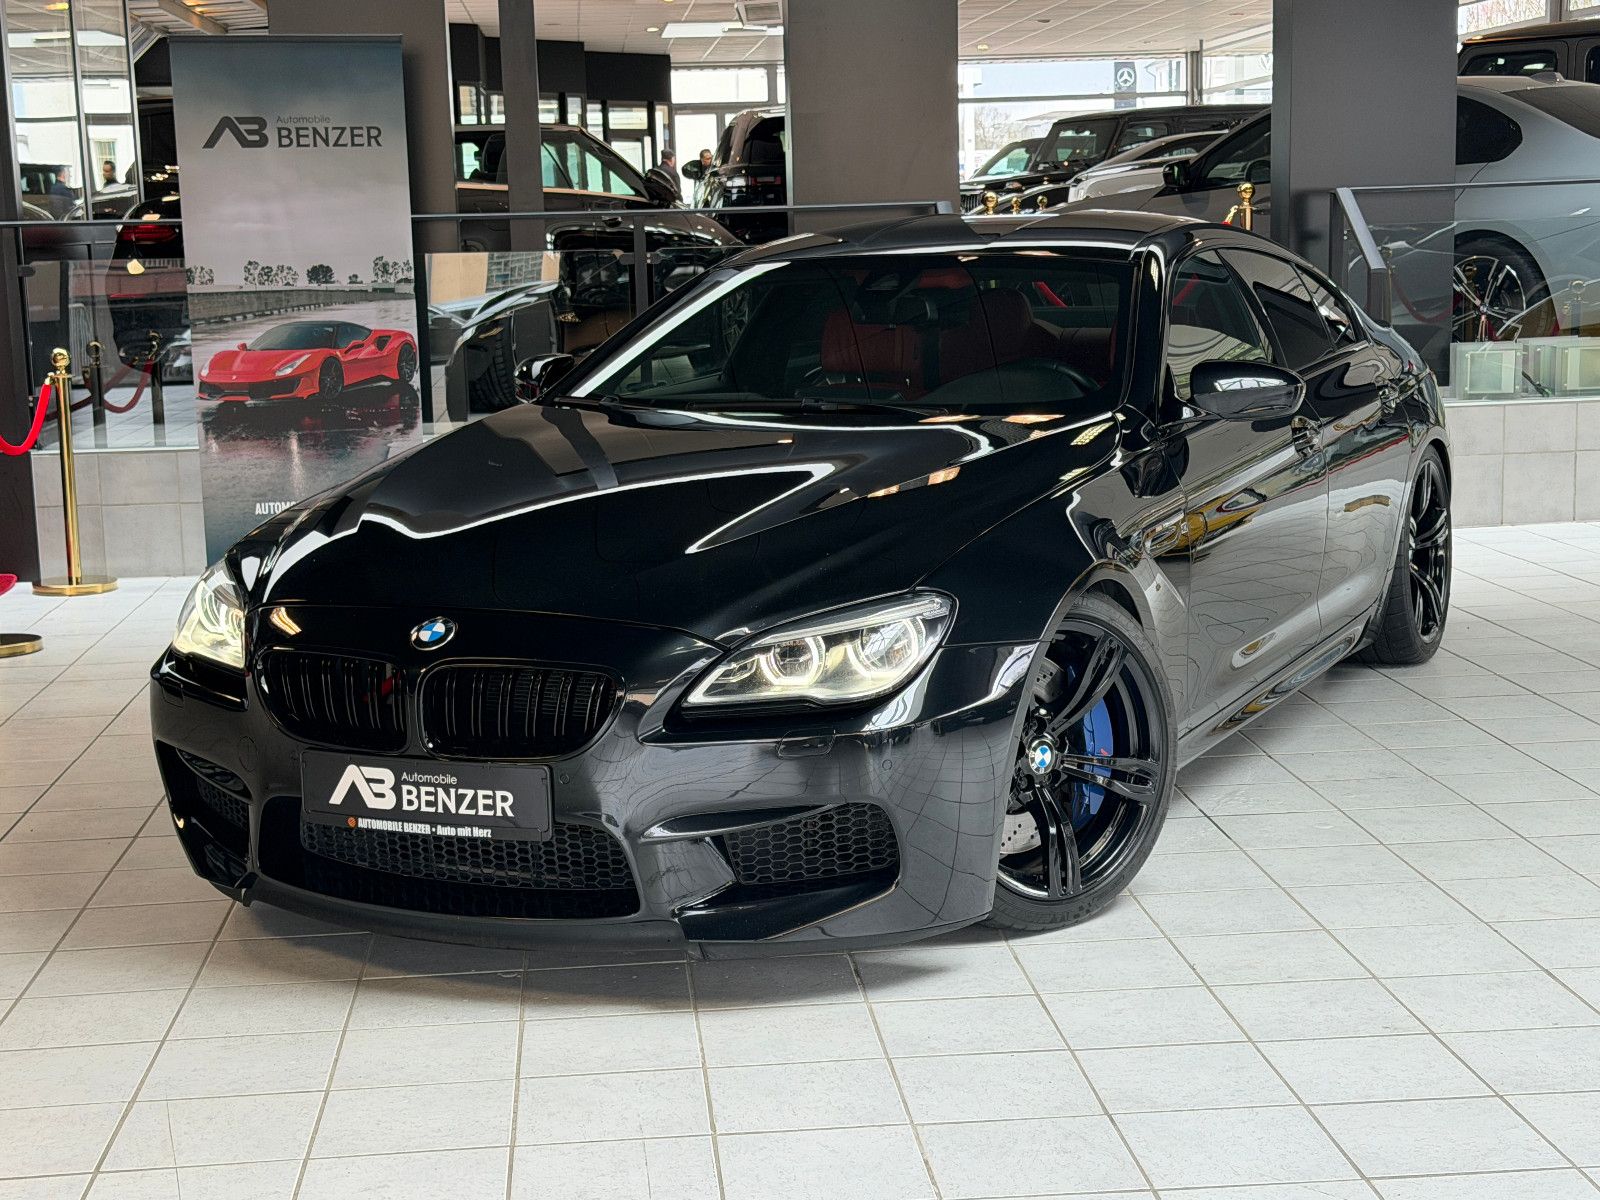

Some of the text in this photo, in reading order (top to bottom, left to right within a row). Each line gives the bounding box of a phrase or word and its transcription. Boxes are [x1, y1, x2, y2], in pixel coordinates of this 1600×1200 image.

[276, 115, 331, 124] Automobile
[276, 126, 383, 148] BENZER
[401, 772, 458, 785] Automobile
[401, 785, 515, 817] BENZER
[357, 818, 492, 838] AUTOMOBILE BENZER Auto mit Herz
